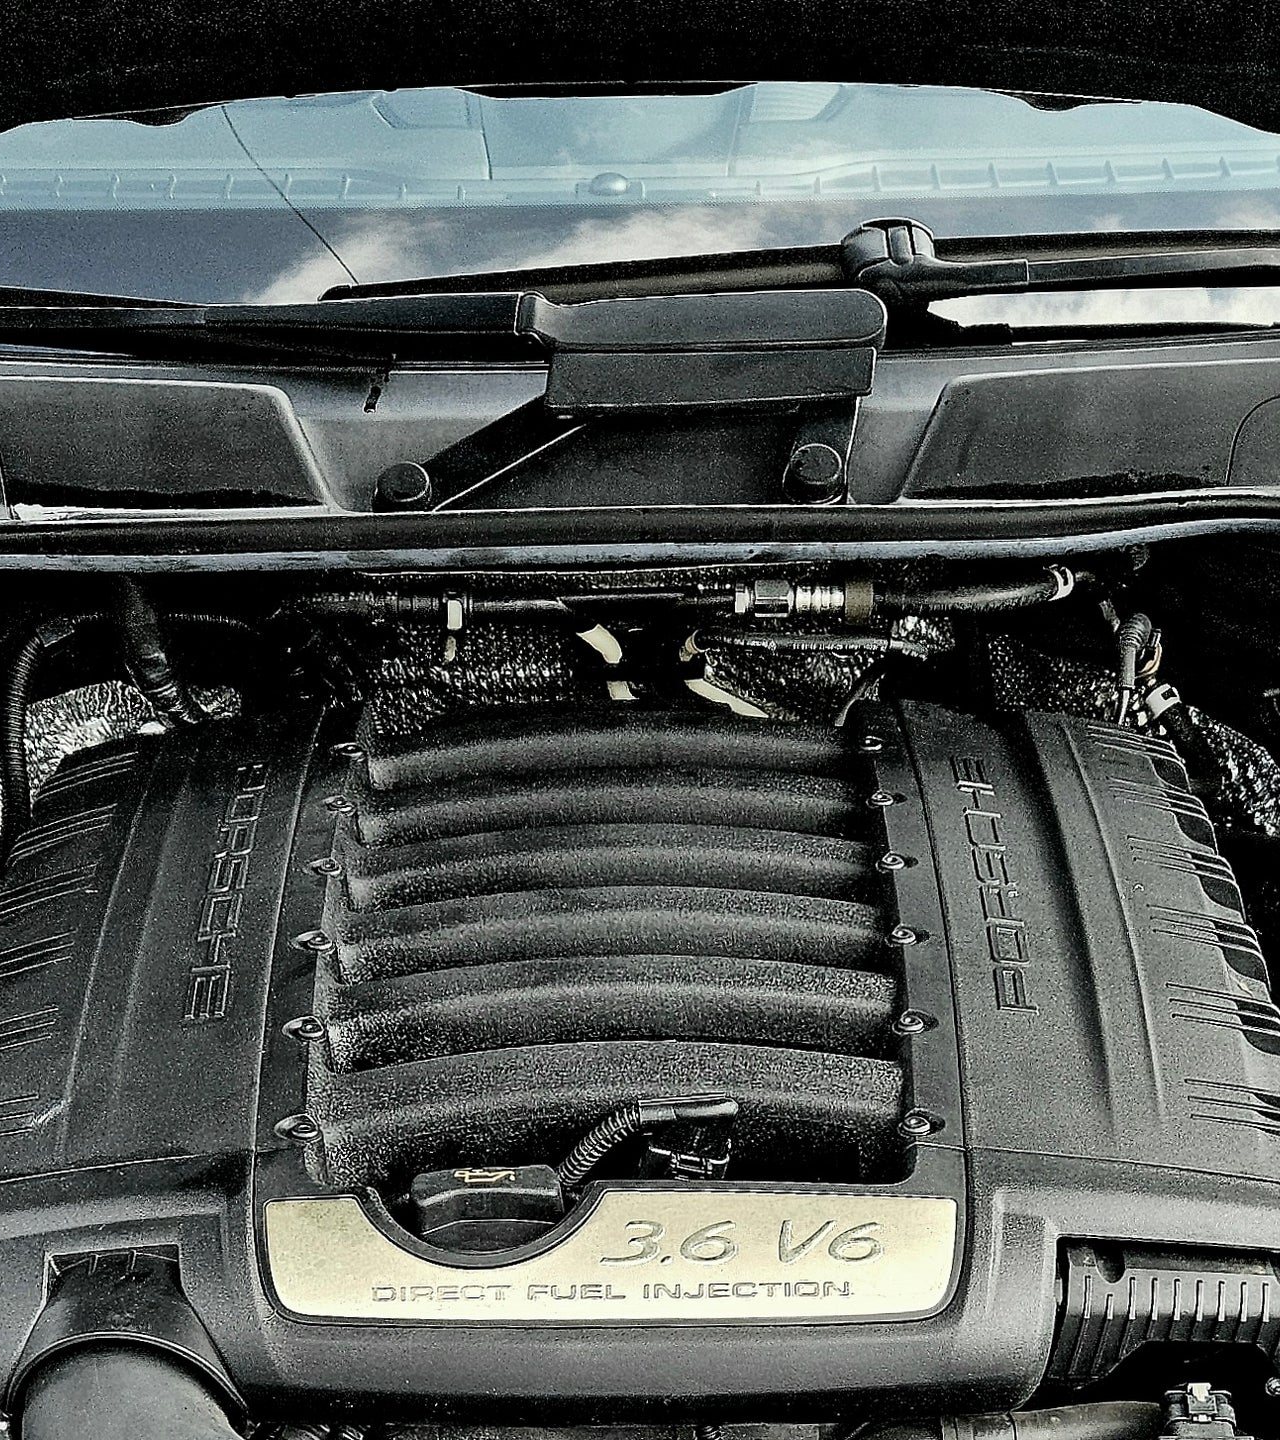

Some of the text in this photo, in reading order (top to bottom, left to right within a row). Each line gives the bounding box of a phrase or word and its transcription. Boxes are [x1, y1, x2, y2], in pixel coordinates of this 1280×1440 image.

[184, 757, 268, 1019] PORSCHE
[950, 756, 1039, 1014] PORSCHE
[371, 1280, 855, 1302] DIRECT FUEL INJECTION
[599, 1218, 883, 1265] 3.6 V6
